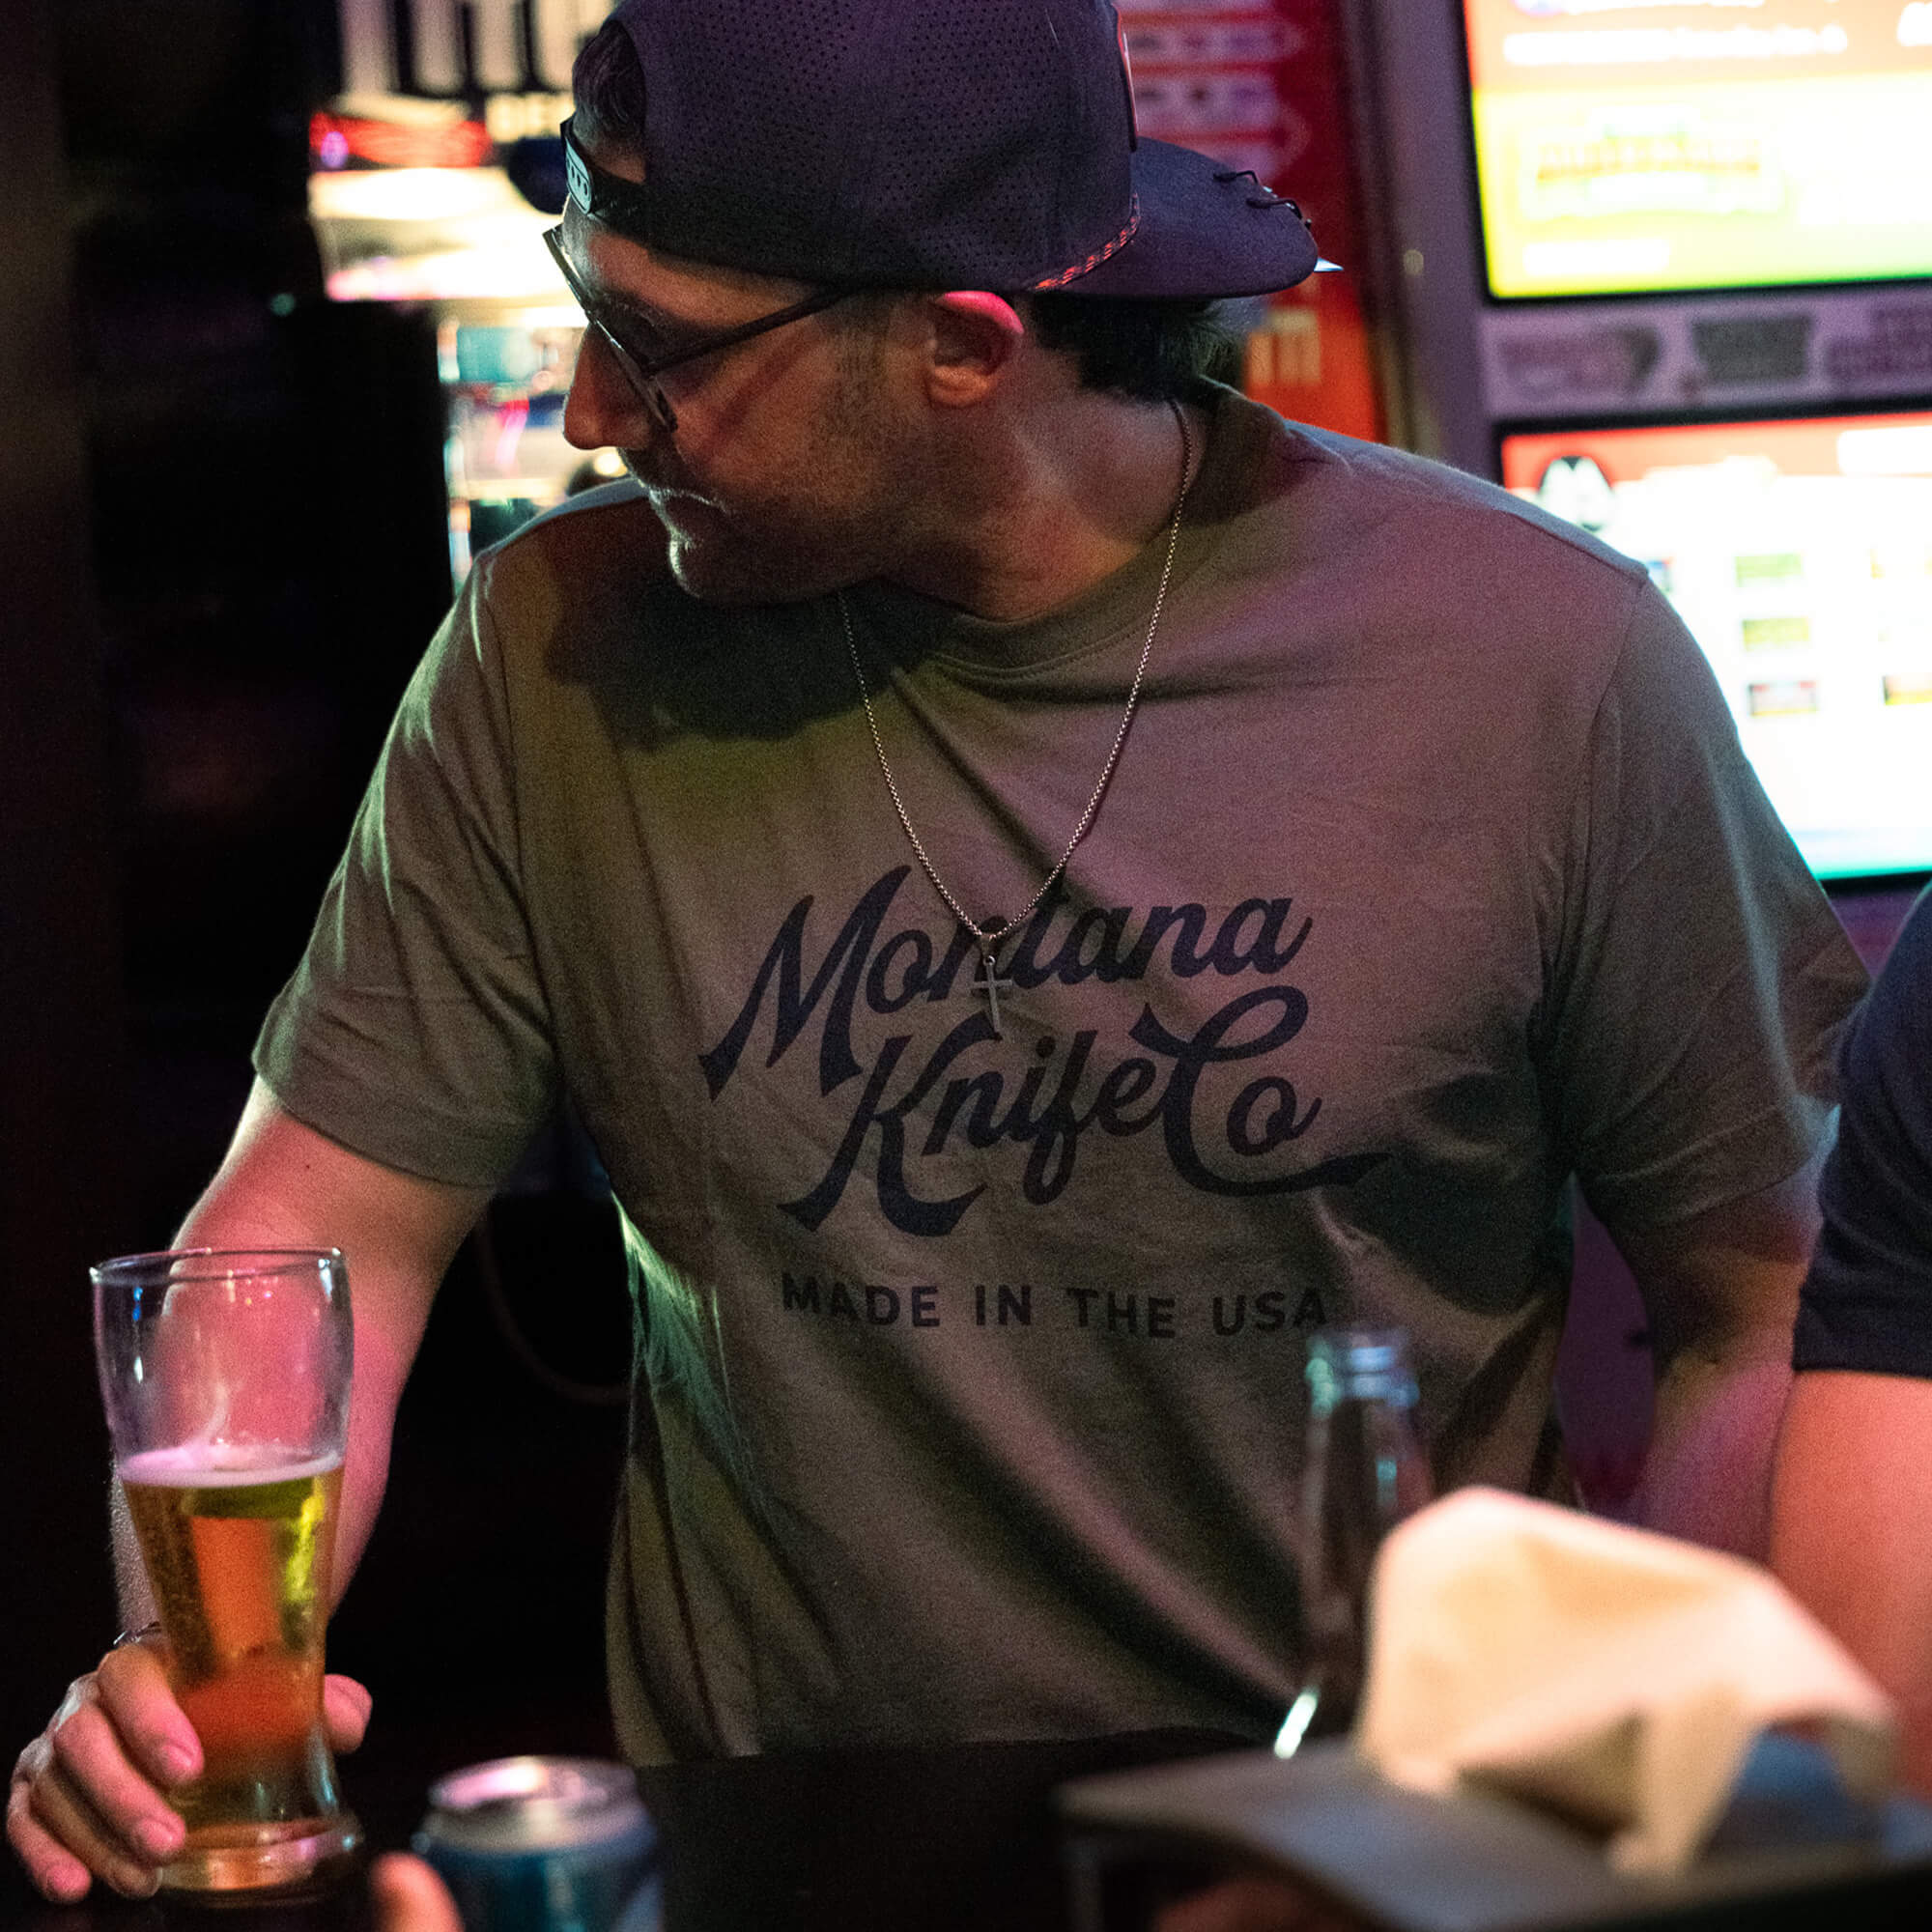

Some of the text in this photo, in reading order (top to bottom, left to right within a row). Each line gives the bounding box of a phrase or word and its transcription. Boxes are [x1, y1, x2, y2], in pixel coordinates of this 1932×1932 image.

[697, 865, 1313, 1100] Montana
[777, 985, 1392, 1236] Knife Co
[781, 1271, 1327, 1339] MADE IN THE USA
